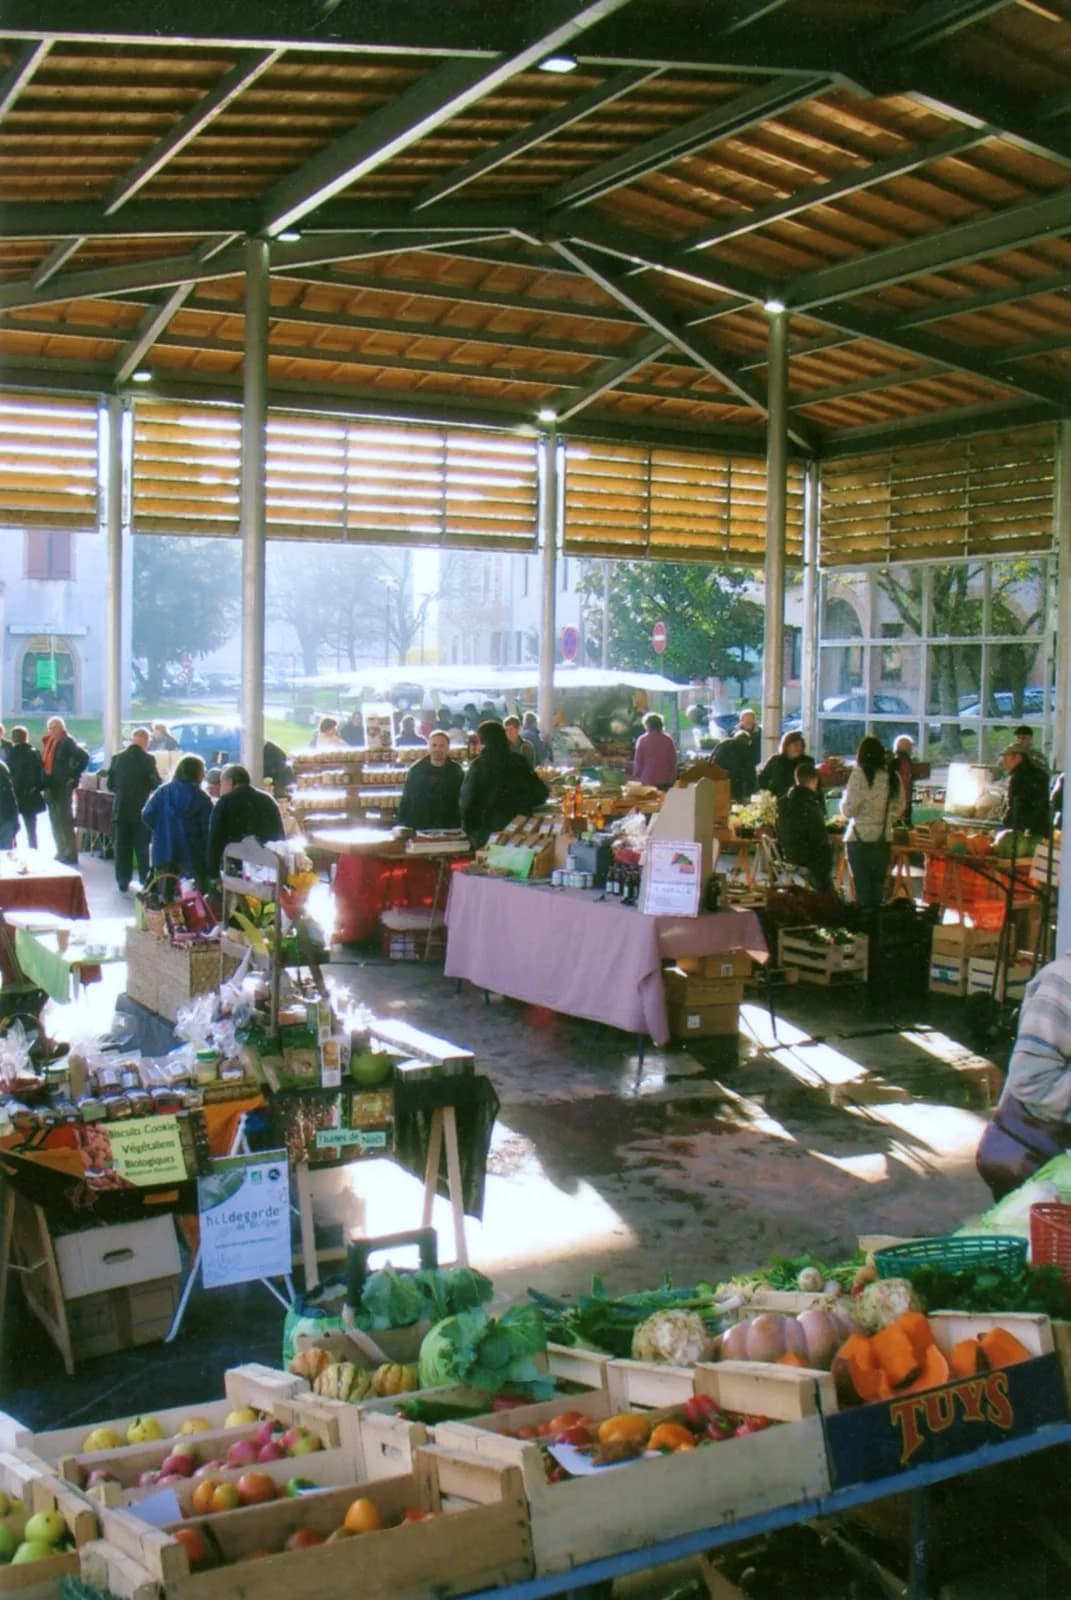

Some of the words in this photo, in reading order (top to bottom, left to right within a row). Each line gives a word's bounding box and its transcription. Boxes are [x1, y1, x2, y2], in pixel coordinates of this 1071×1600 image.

[121, 1140, 176, 1154] Végétaliens
[124, 1156, 175, 1169] Biologiques
[205, 1205, 280, 1226] hildegarde
[890, 1371, 1014, 1464] TUYS
